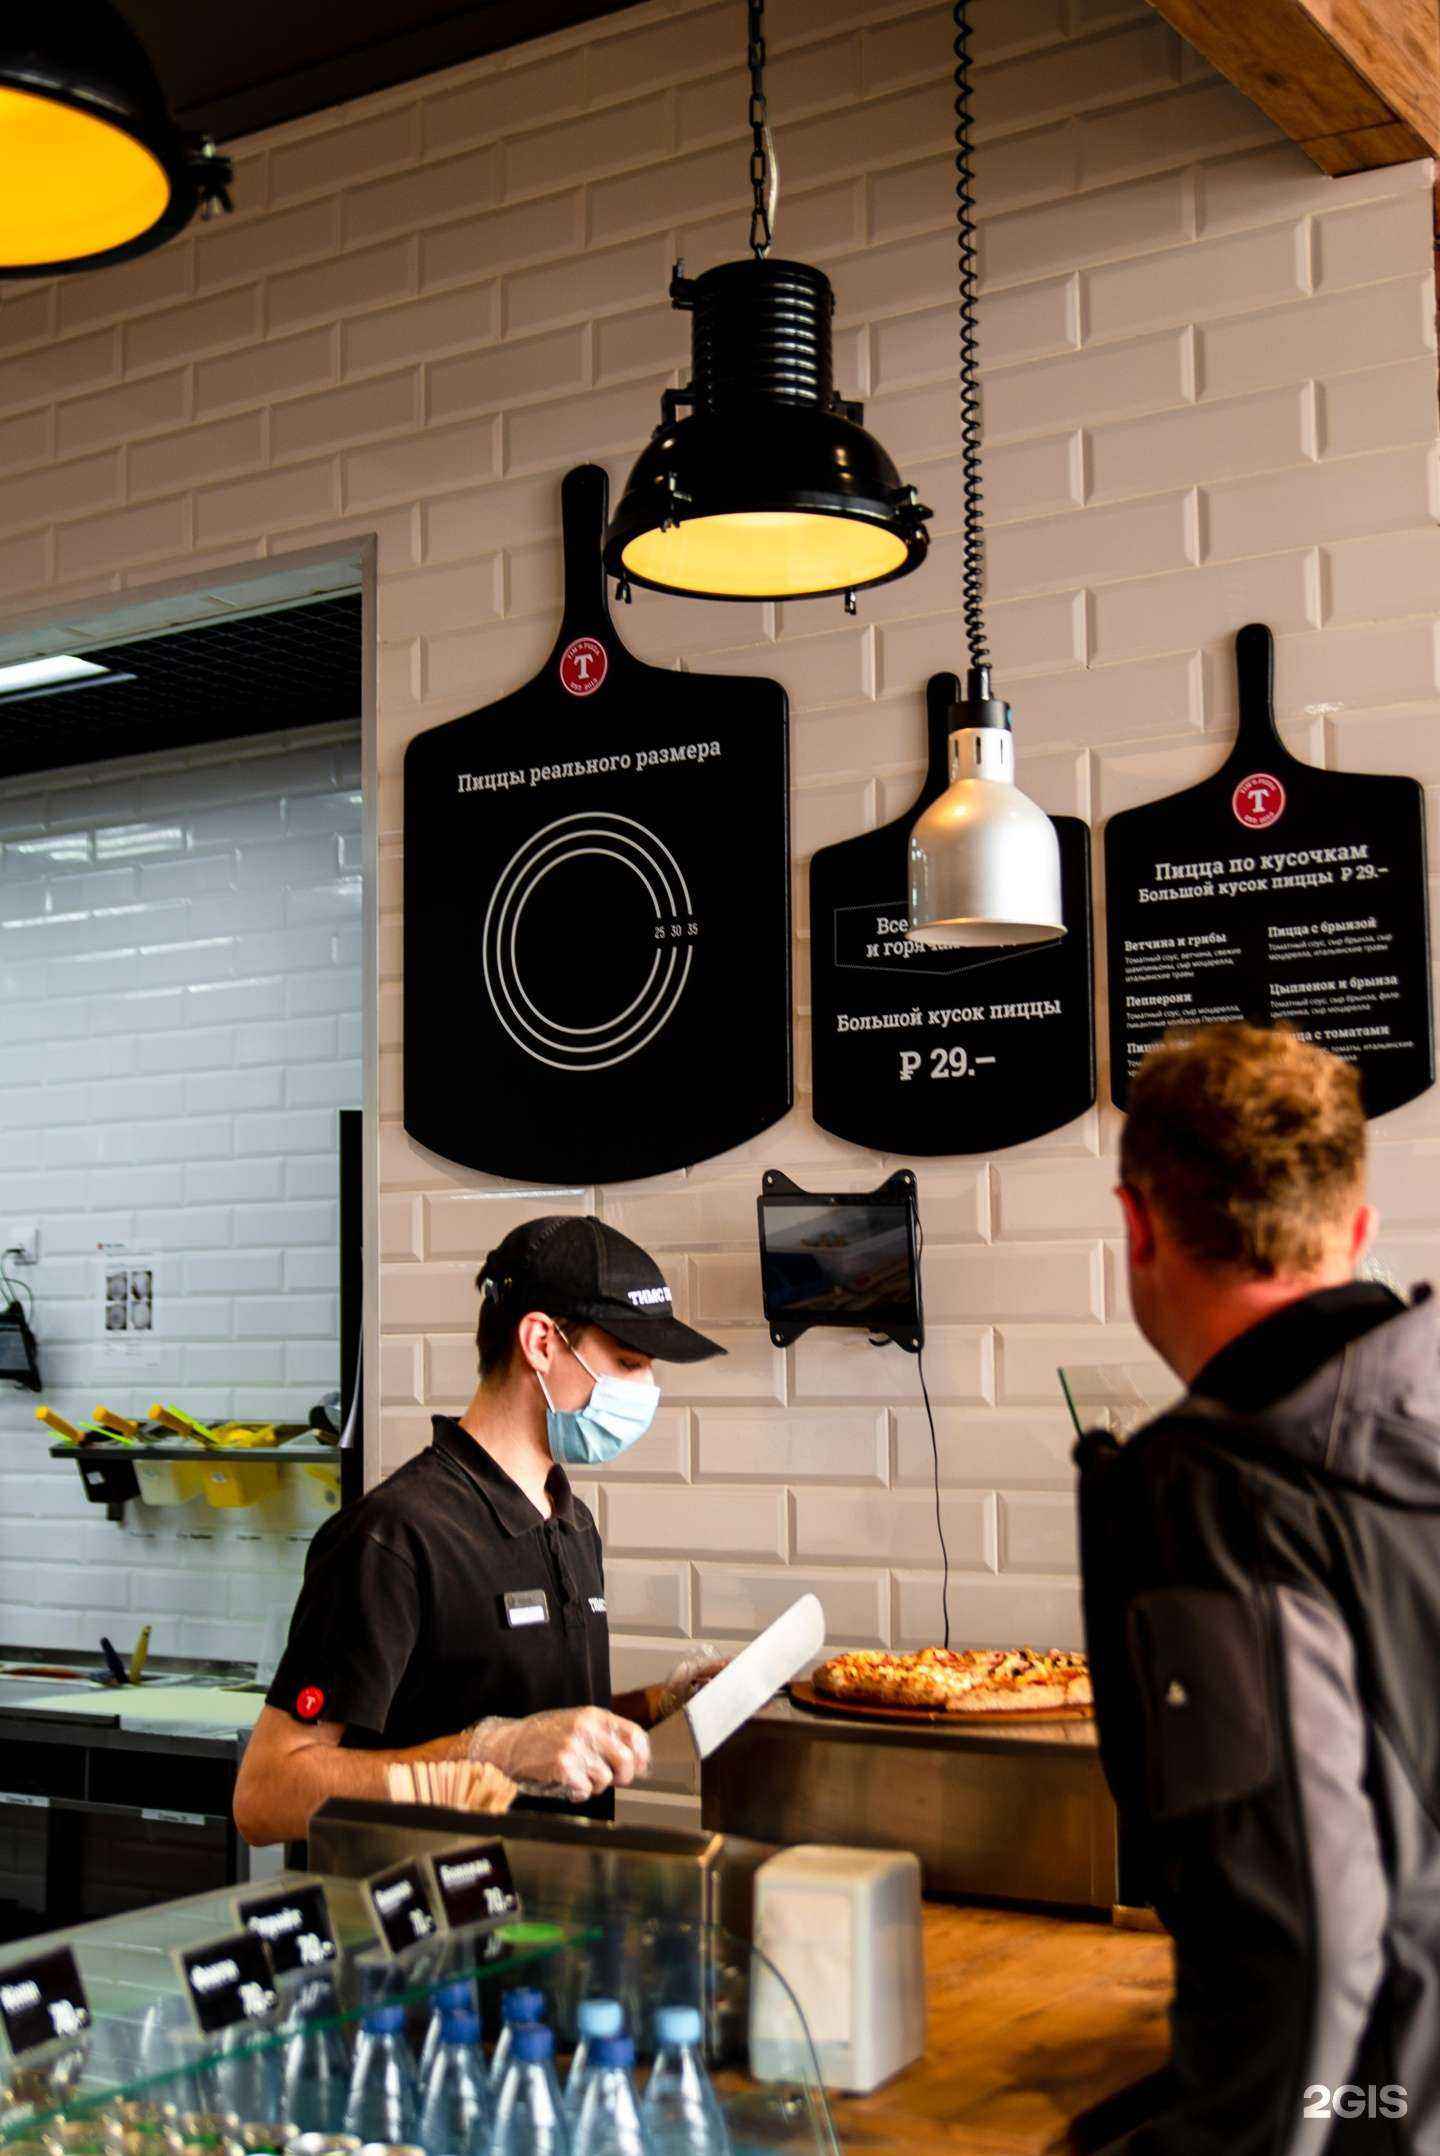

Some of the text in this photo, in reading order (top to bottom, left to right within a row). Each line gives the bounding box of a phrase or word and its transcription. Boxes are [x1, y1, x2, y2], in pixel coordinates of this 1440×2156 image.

[574, 653, 593, 680] T
[457, 740, 721, 792] Пиццы реального размера
[1248, 789, 1269, 813] T
[1154, 844, 1369, 881] Пицца по кусочкам
[1137, 881, 1215, 903] Большой
[1218, 876, 1268, 896] кусок
[1271, 870, 1334, 889] пиццы
[654, 922, 698, 939] 25 30 35
[876, 917, 909, 935] Все
[1267, 916, 1377, 938] Пицца с брынзой
[865, 943, 879, 958] и
[1124, 931, 1227, 952] Ветчина и грибы
[1338, 980, 1347, 990] и
[1349, 975, 1399, 990] брынза
[1125, 993, 1192, 1007] Пепперони
[836, 999, 1062, 1032] Большой кусок пиццы
[1314, 1030, 1322, 1040] с
[1323, 1025, 1390, 1040] томатами
